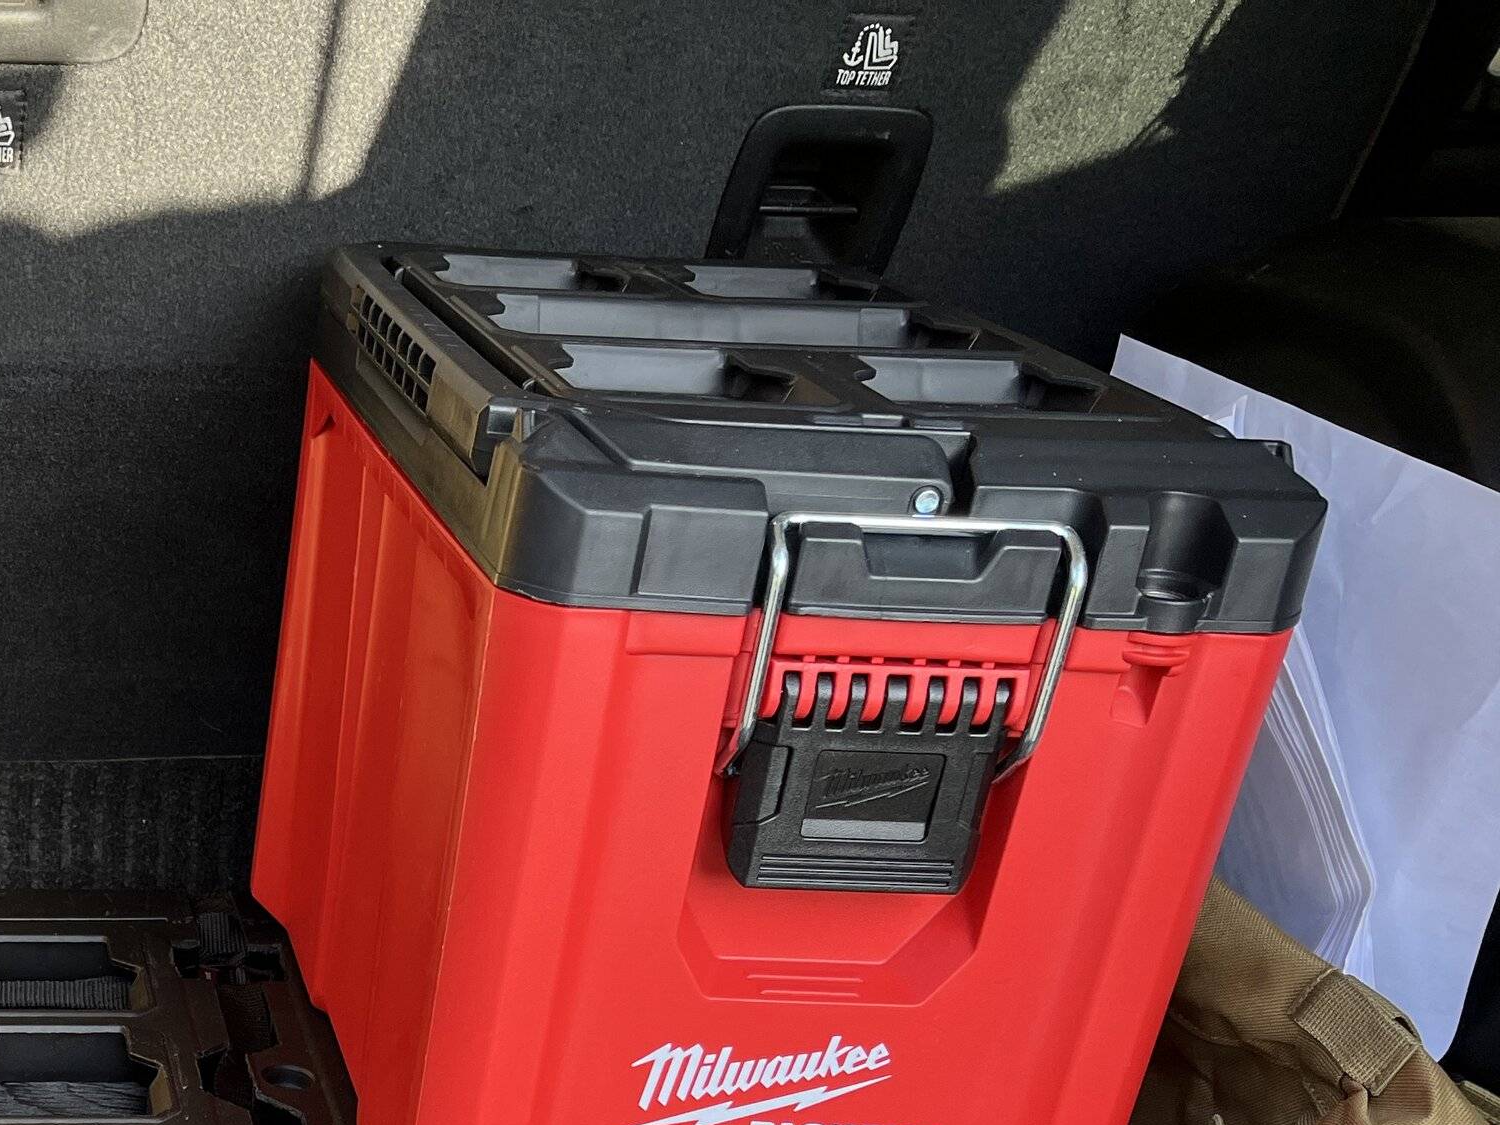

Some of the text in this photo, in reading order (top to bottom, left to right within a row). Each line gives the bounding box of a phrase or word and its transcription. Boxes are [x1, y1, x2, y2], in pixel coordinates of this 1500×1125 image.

[836, 69, 892, 86] TOP TETHER
[631, 1034, 891, 1111] Milwaukee
